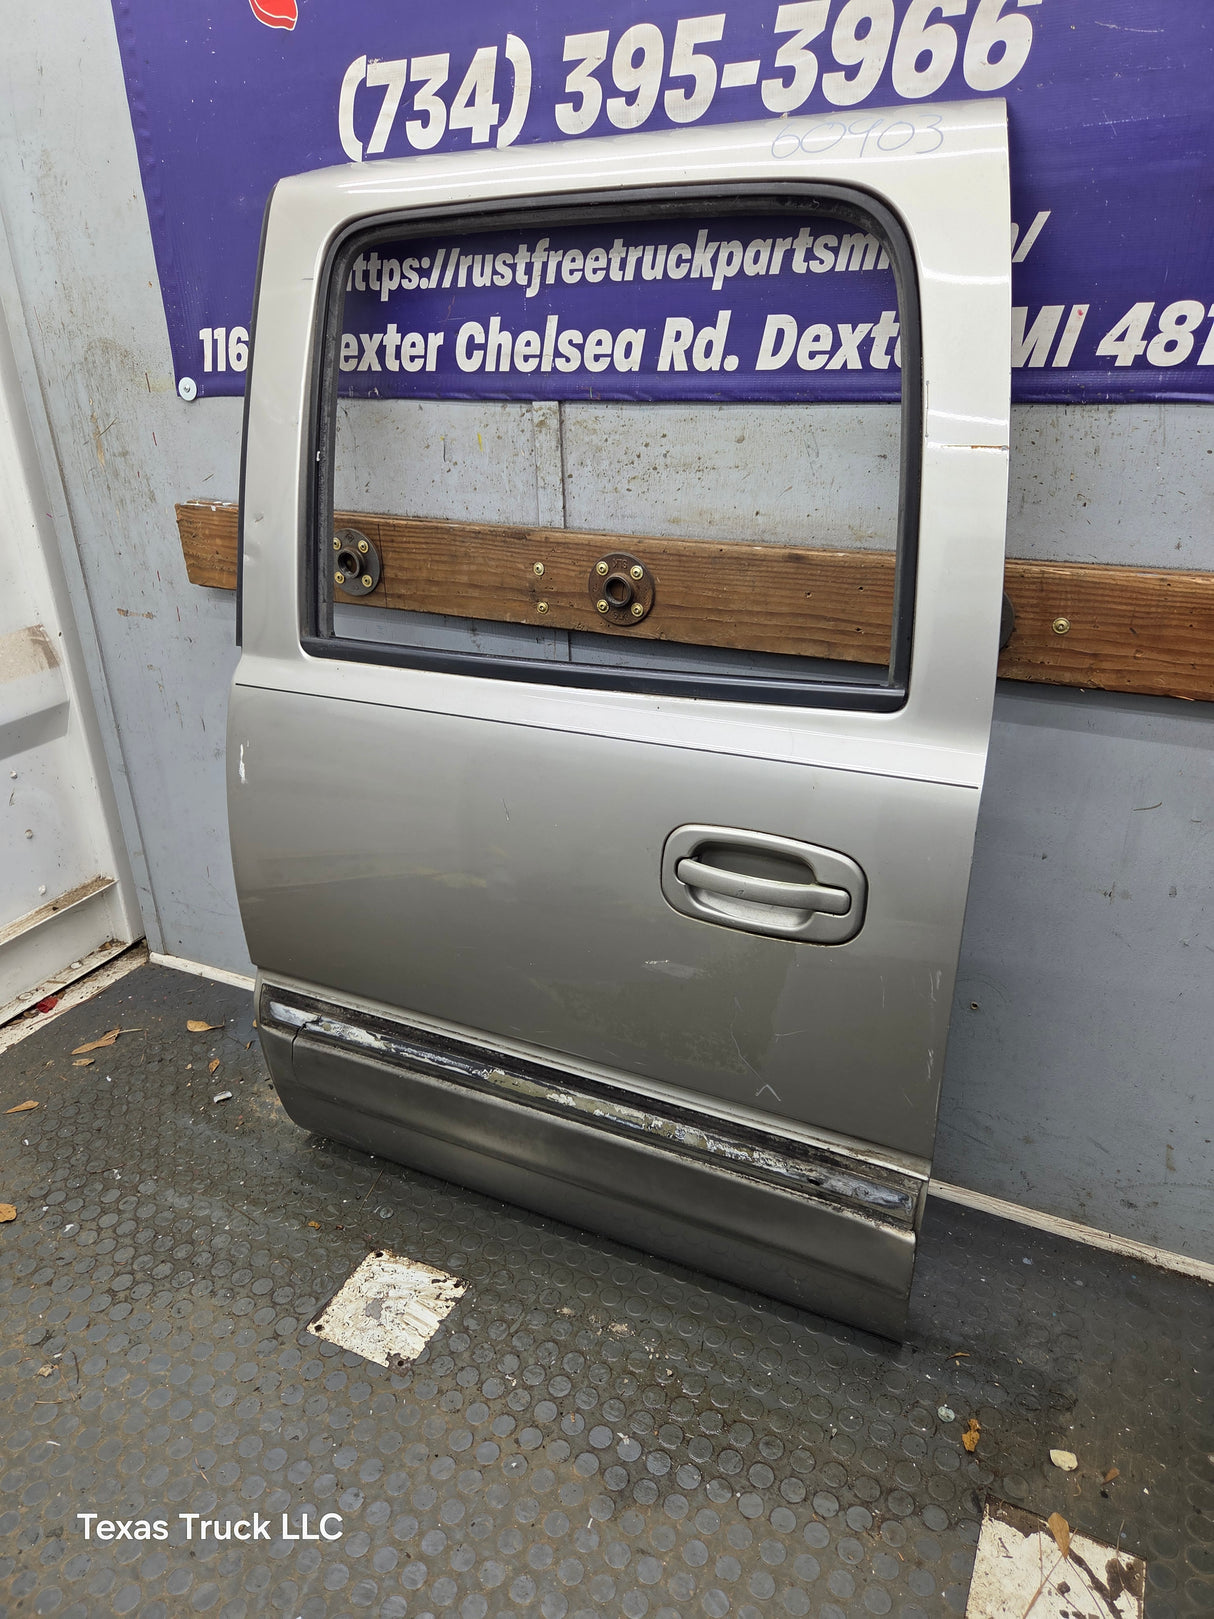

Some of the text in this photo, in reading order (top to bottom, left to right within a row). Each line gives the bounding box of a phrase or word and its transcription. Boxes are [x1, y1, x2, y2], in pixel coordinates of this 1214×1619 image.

[339, 0, 1043, 162] (734) 395-3966
[771, 113, 944, 159] 60903
[199, 326, 249, 373] 116
[340, 323, 445, 373] exter
[455, 314, 647, 373] Chelsea
[656, 310, 740, 372] Rd.
[755, 310, 902, 372] Dext
[1011, 303, 1090, 368] MI
